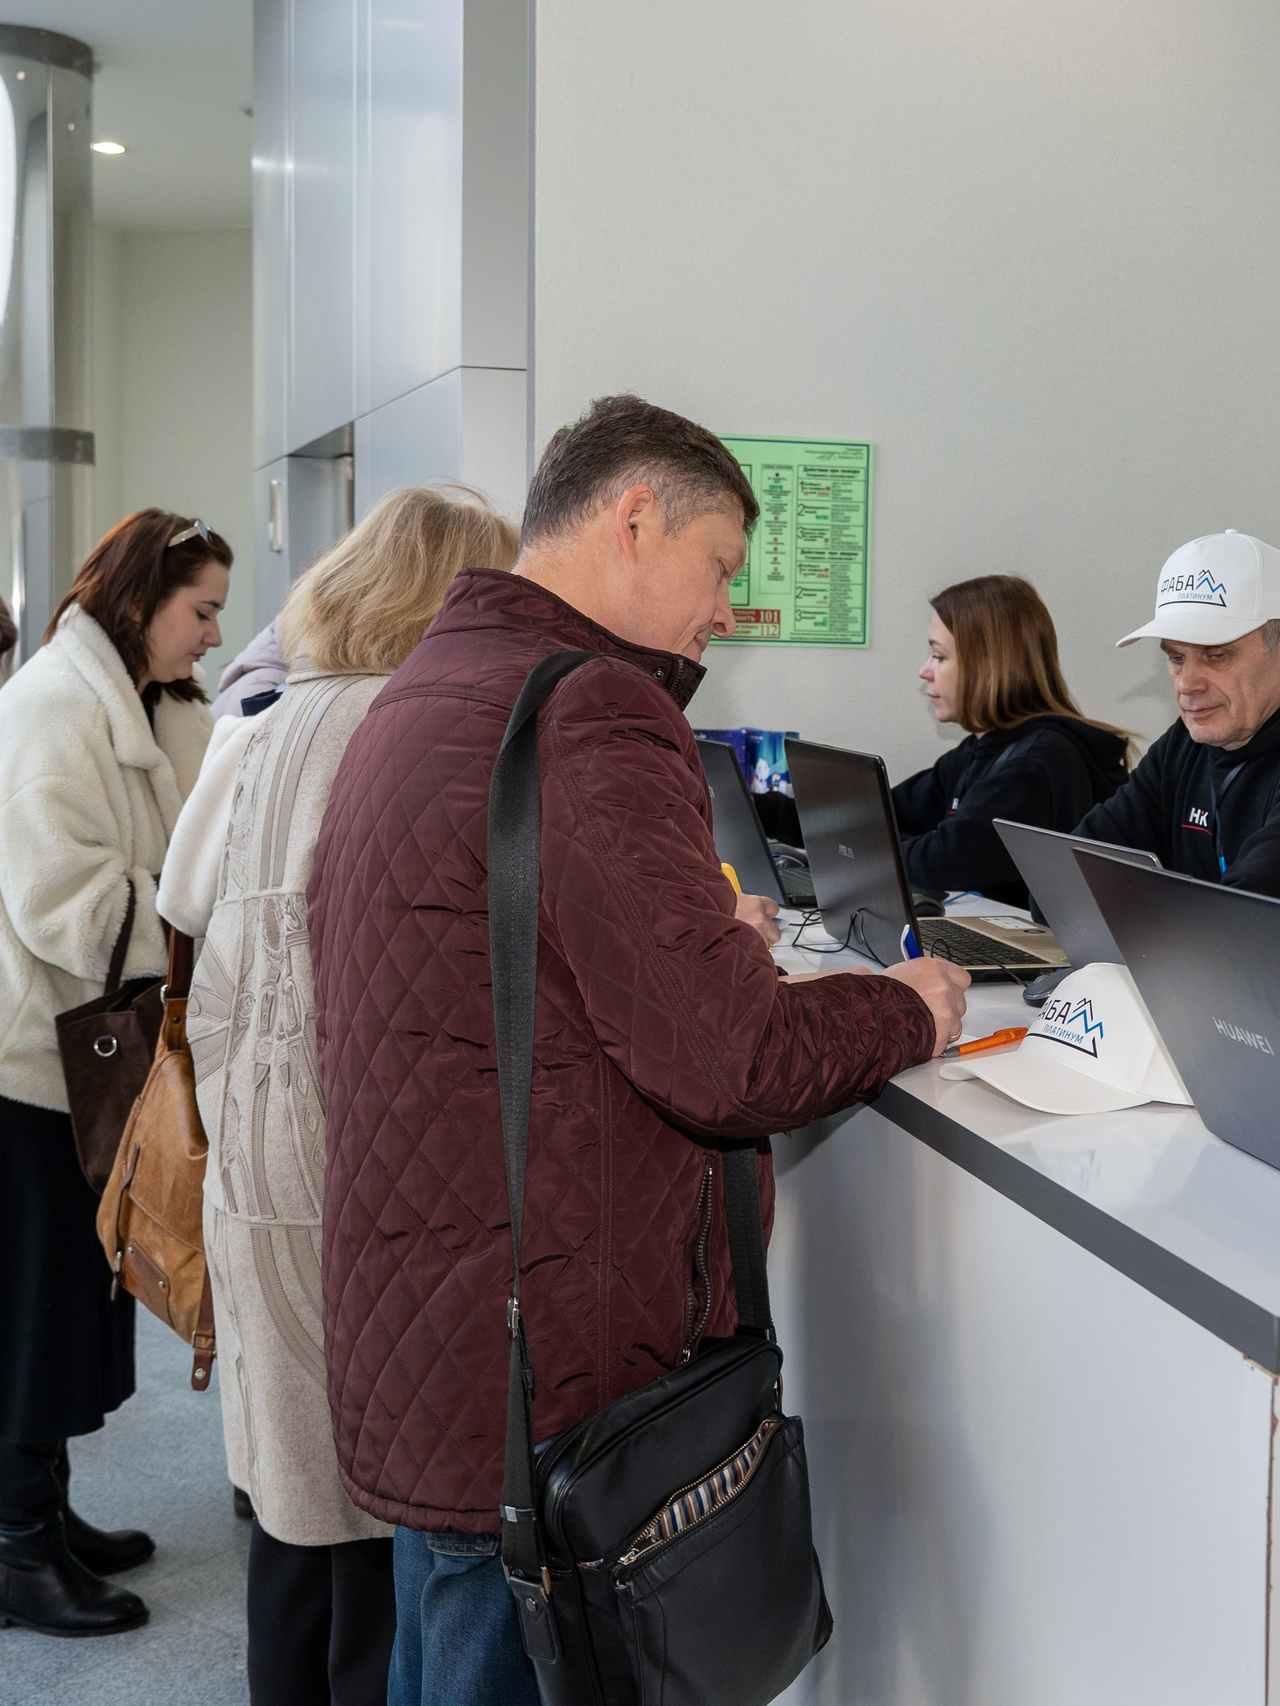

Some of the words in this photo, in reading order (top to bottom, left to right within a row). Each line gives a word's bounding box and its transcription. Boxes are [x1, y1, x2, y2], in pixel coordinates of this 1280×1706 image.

[1177, 593, 1213, 601] ПЛАТИНУМ
[760, 611, 778, 622] 101
[760, 624, 778, 636] 112
[1043, 1023, 1084, 1044] ПЛАТИНУМ
[1212, 1016, 1275, 1056] HUAWEI
